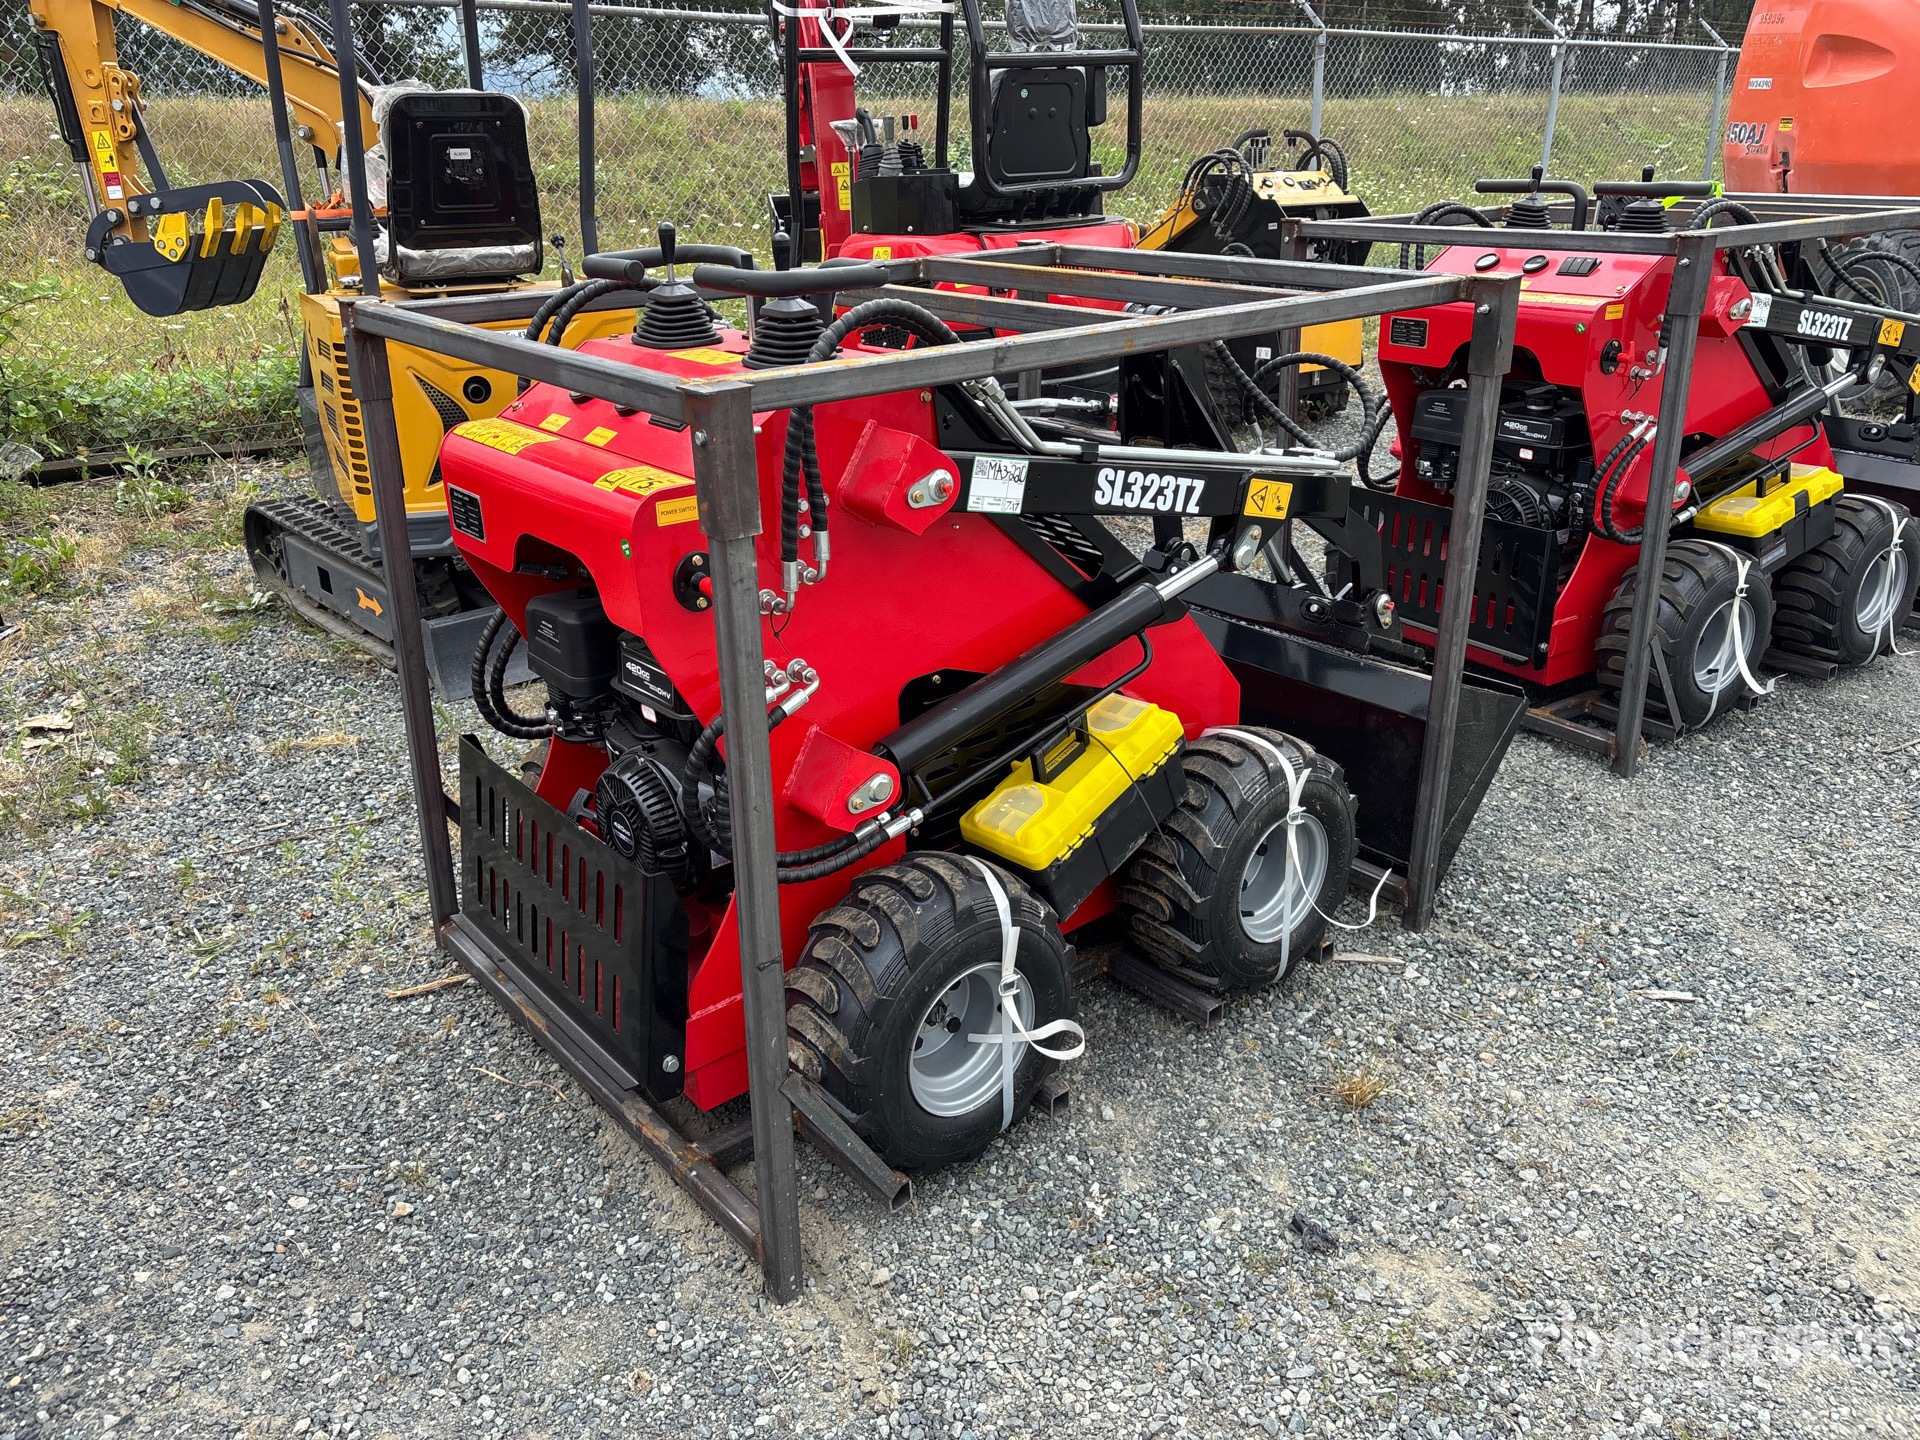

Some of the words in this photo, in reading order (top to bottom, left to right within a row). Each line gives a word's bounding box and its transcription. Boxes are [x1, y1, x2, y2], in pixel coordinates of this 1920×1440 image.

[1797, 309, 1853, 341] SL323TZ
[1094, 467, 1206, 514] SL323TZ
[661, 508, 678, 517] POWER
[678, 505, 697, 514] SWITCH
[626, 661, 651, 679] 420cc
